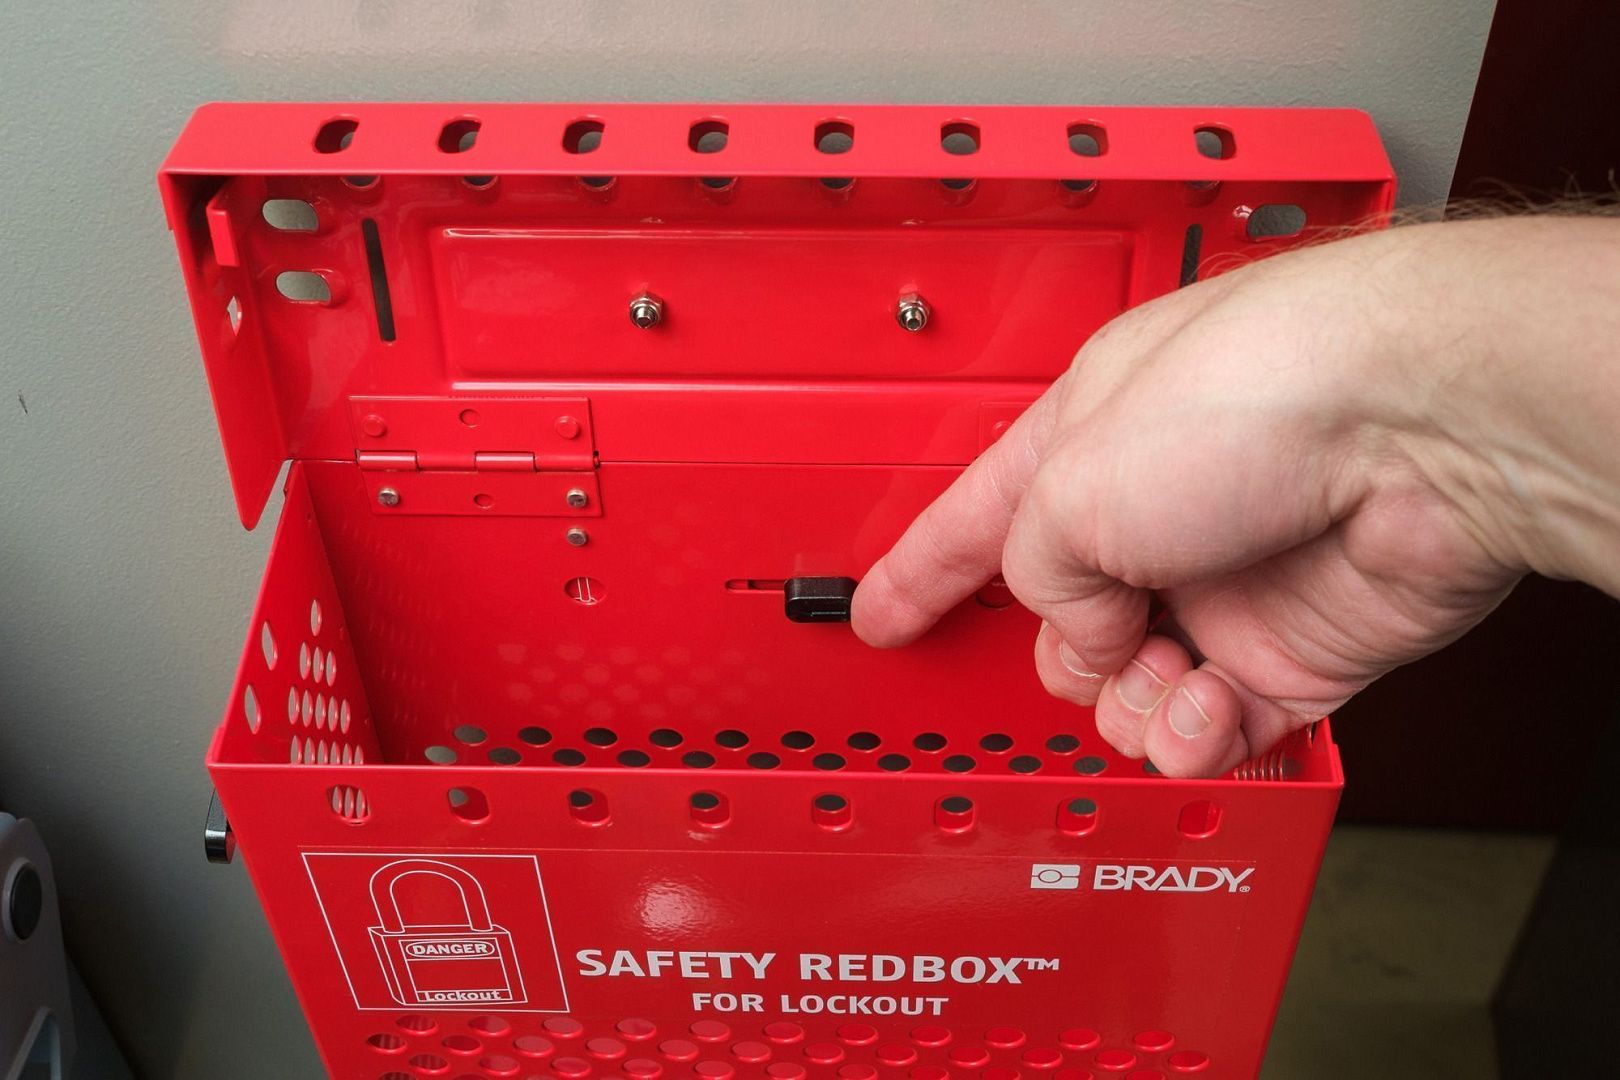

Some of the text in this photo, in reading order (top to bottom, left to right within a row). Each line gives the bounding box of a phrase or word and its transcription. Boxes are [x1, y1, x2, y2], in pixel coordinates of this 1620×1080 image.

[412, 943, 488, 955] DANGER
[576, 950, 775, 978] SAFETY
[425, 989, 501, 1002] Lockout
[693, 993, 948, 1015] FOR LOCKOUT
